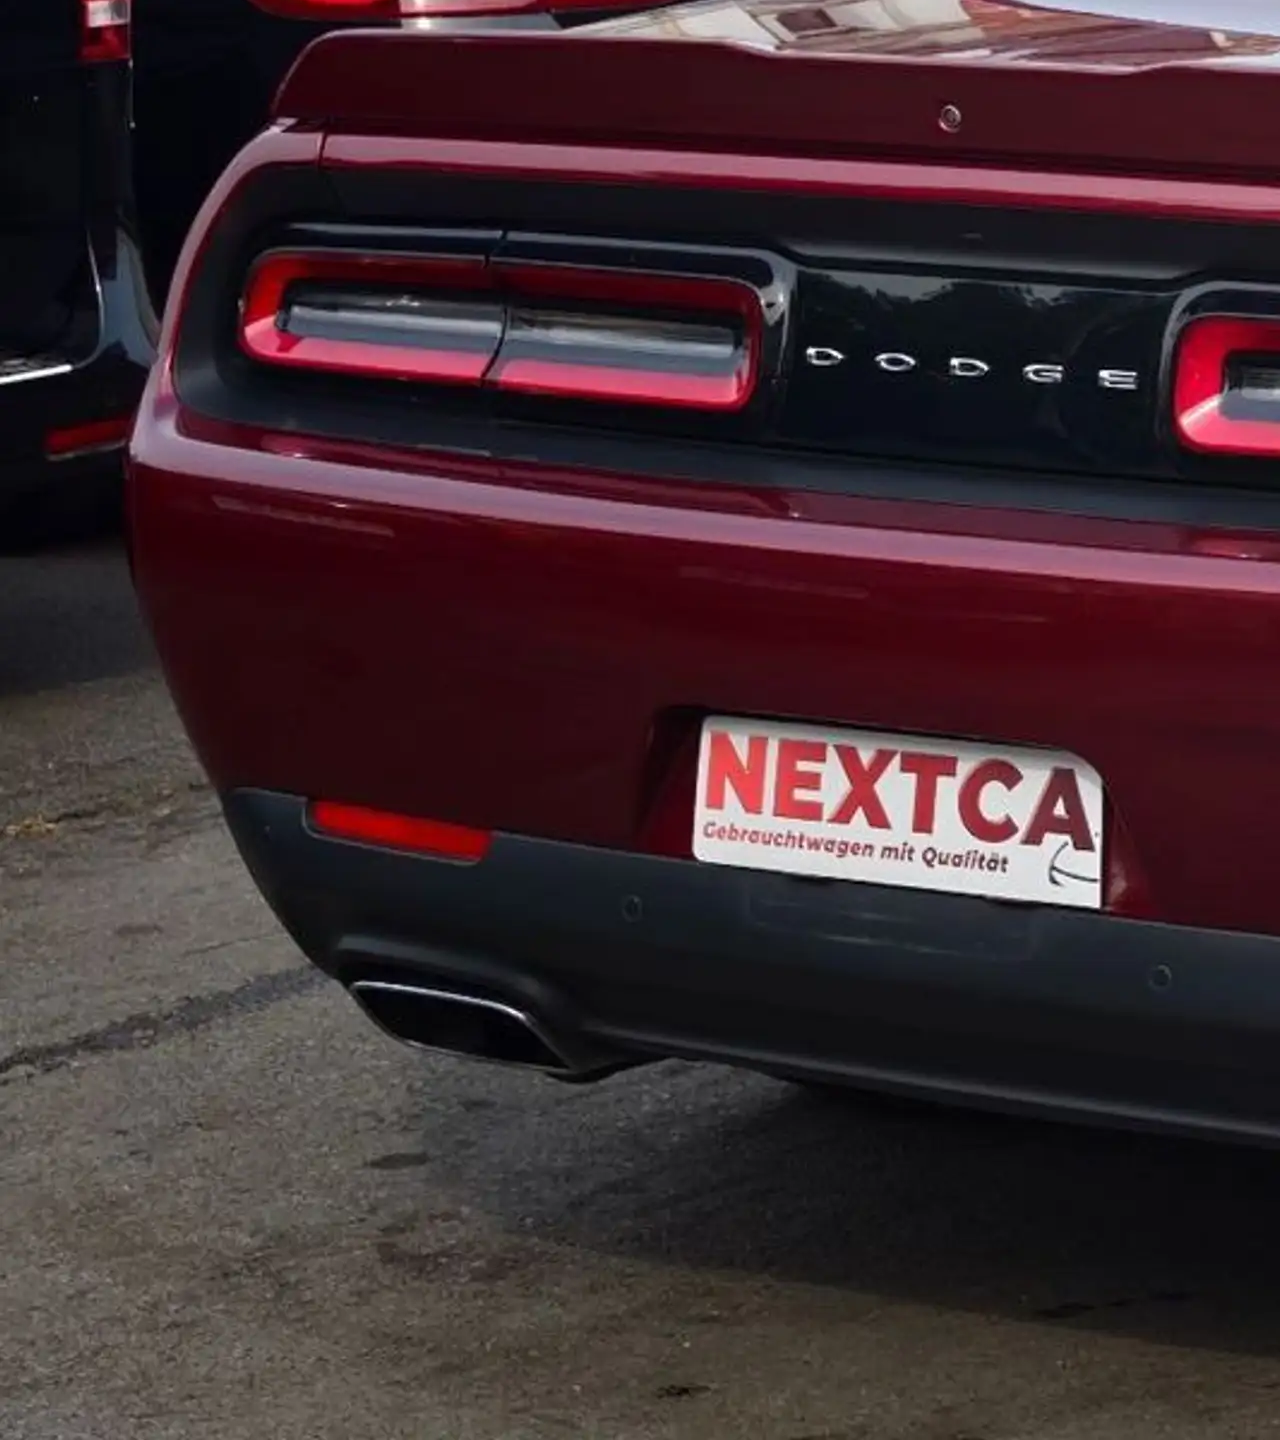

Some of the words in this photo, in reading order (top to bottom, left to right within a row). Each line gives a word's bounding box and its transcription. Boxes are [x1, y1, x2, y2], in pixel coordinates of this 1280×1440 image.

[806, 346, 1137, 390] DODGE
[705, 729, 1096, 852] NEXTCA
[703, 821, 875, 858] Gebrauchtwagen
[880, 842, 916, 862] mit
[921, 846, 1009, 873] Qualität
